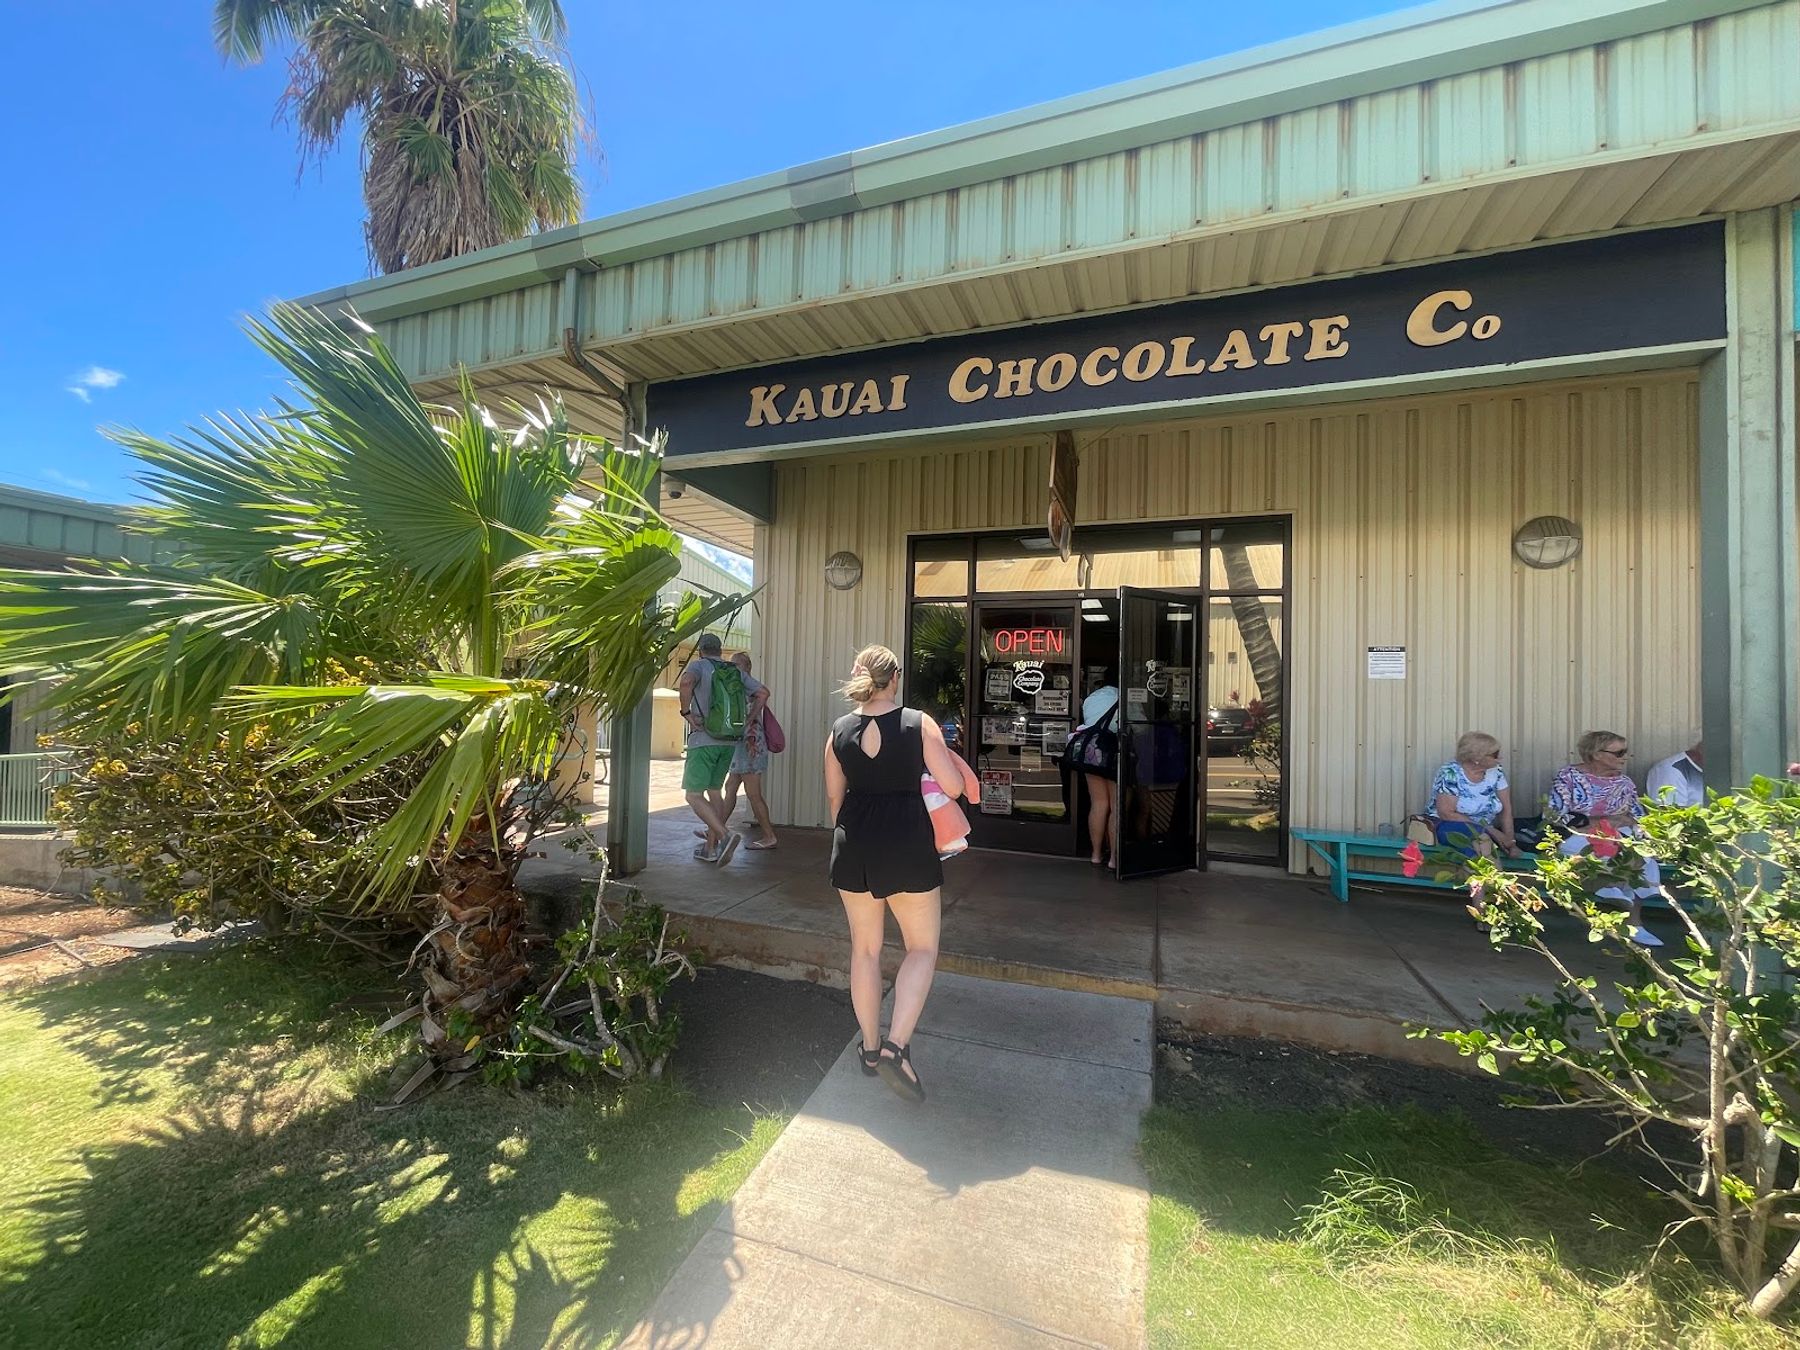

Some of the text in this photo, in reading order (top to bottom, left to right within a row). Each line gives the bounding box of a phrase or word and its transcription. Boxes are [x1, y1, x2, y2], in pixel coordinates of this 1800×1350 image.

[744, 374, 911, 428] KAUAI
[947, 314, 1351, 404] CHOCOLATE
[995, 629, 1062, 653] OPEN
[1013, 660, 1045, 673] Kauai
